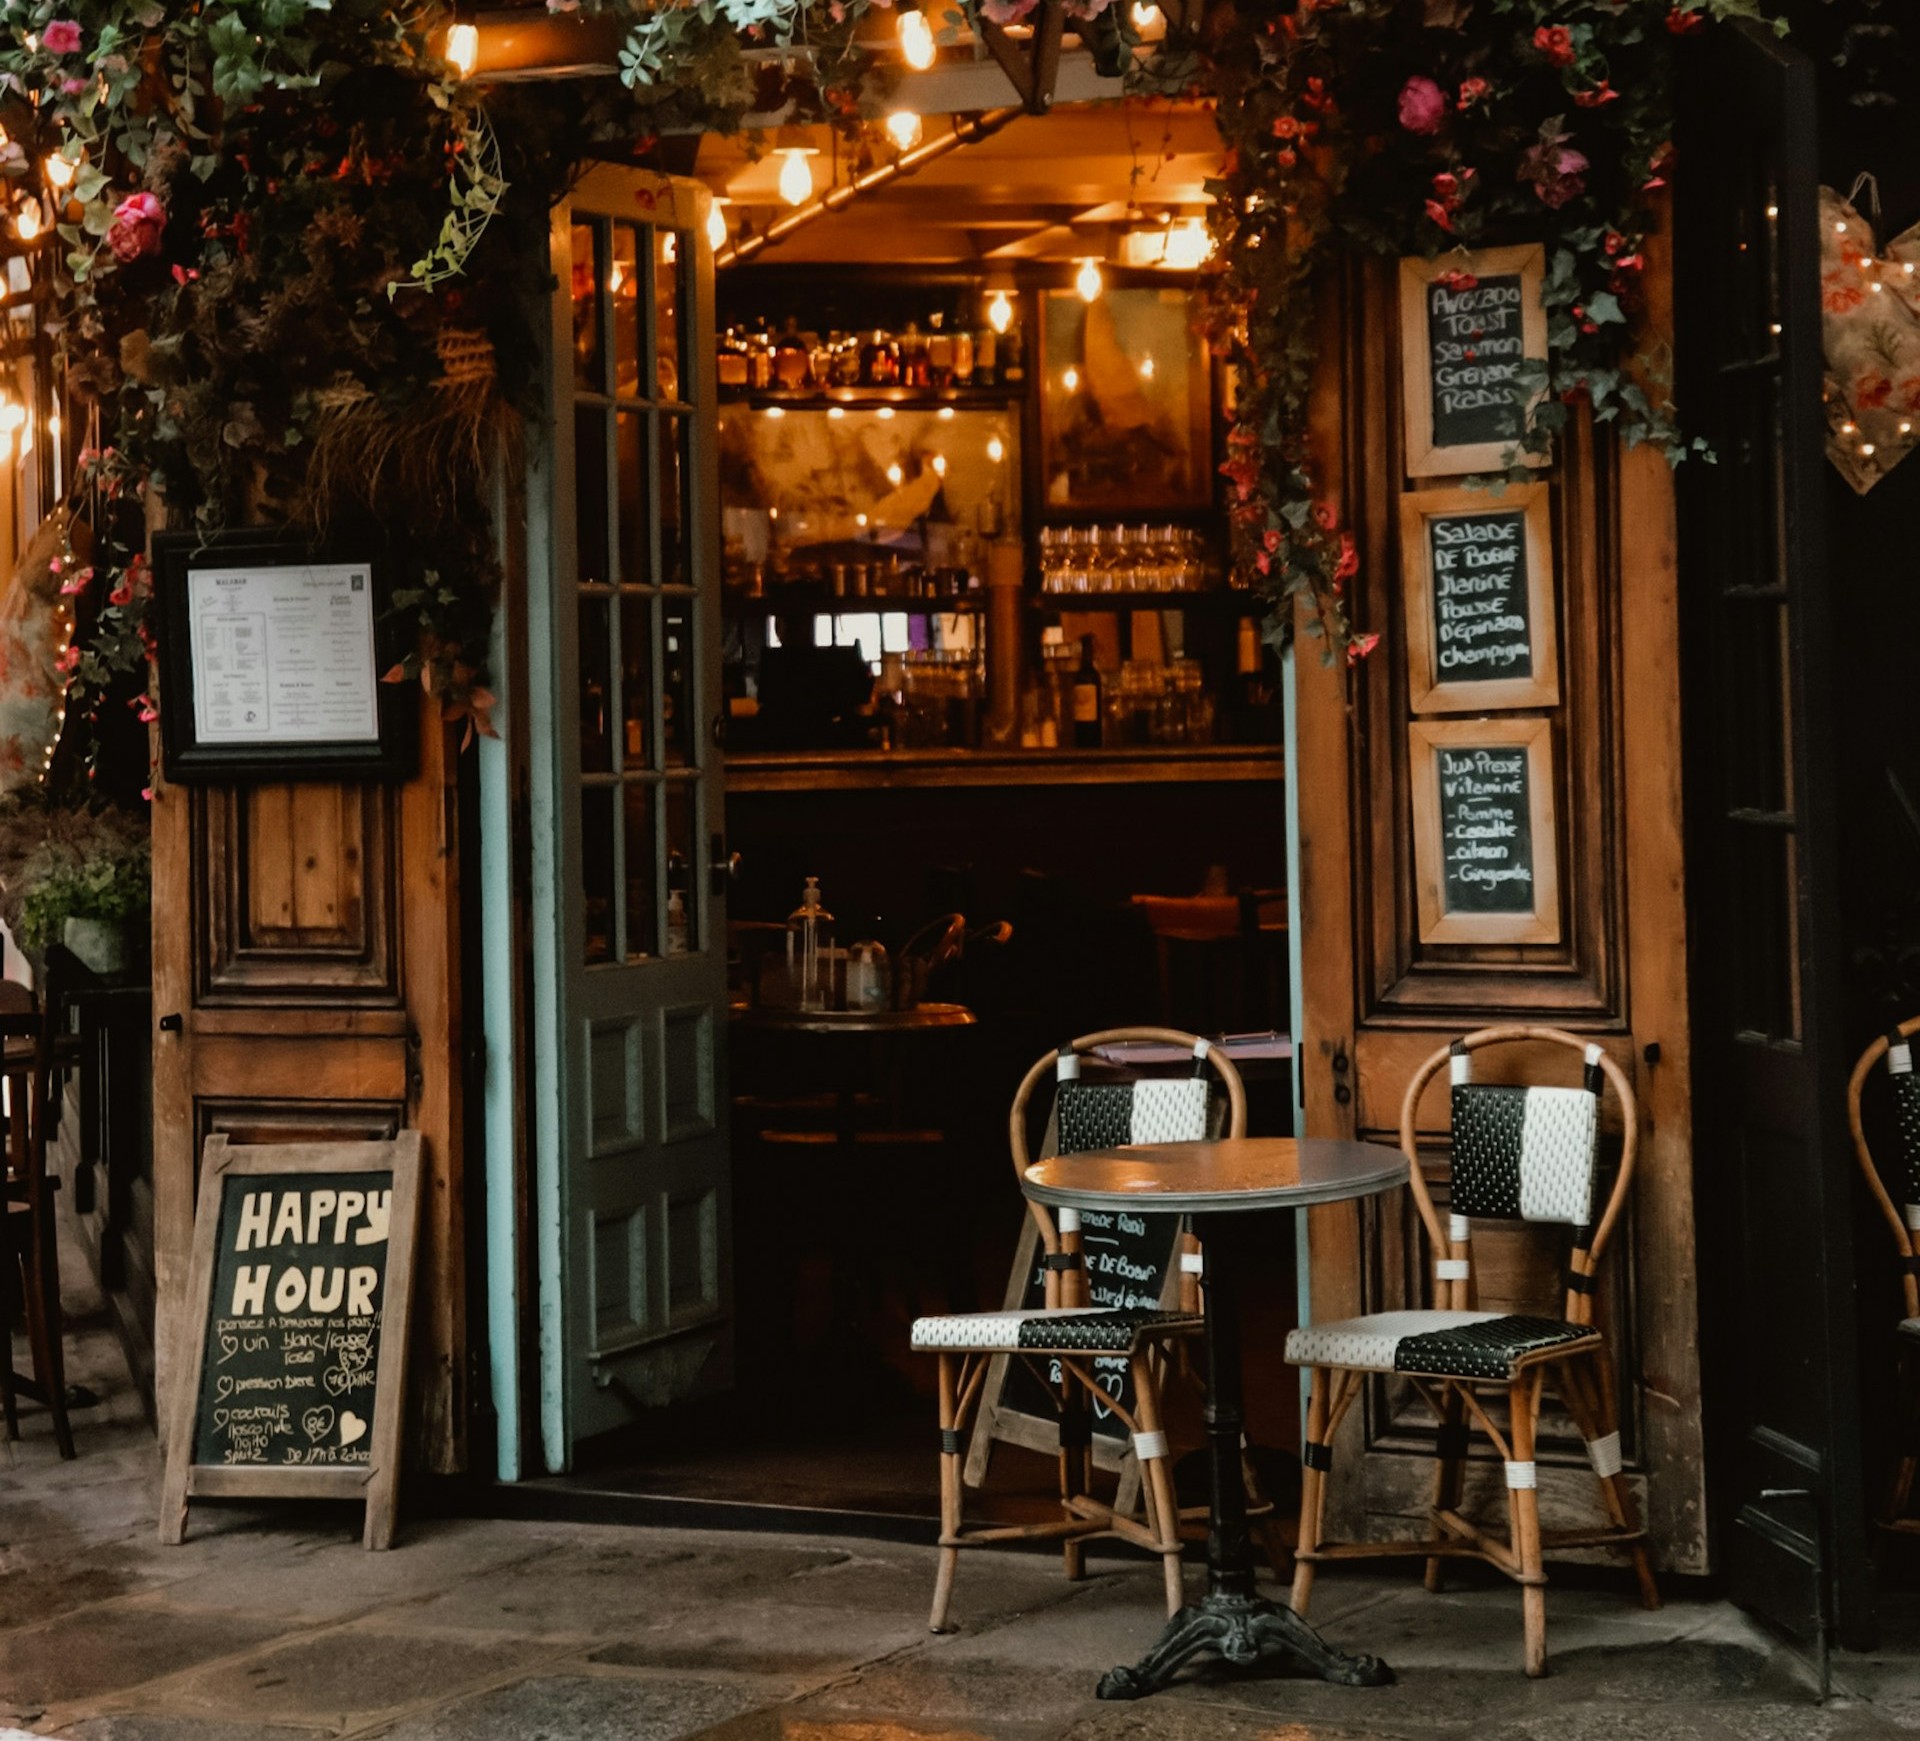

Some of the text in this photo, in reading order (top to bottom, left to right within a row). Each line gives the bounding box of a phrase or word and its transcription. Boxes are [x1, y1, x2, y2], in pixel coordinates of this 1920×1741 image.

[1435, 549, 1461, 570] DE
[235, 1190, 392, 1252] HAPPY
[232, 1264, 378, 1317] HOUR
